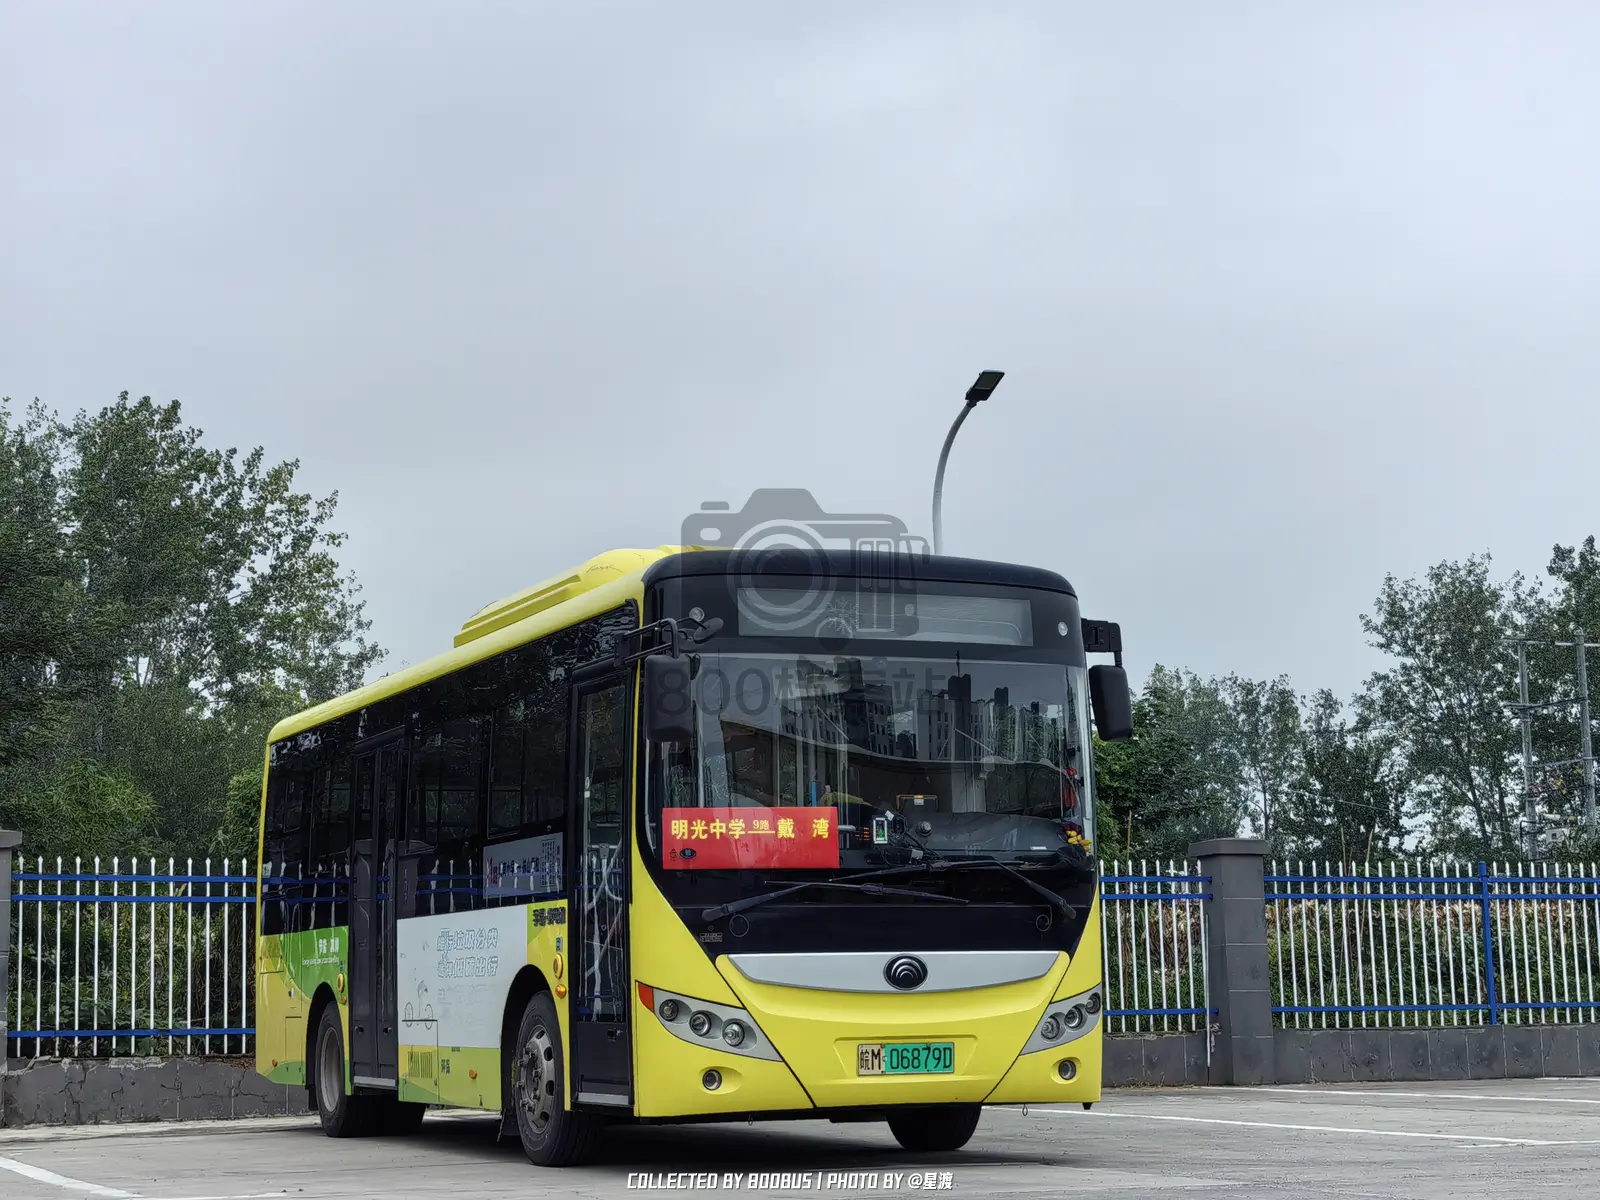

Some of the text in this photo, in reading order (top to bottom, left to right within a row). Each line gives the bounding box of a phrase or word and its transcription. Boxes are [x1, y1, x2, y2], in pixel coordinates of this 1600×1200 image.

[671, 818, 746, 840] 明光中学
[752, 819, 769, 831] 9路
